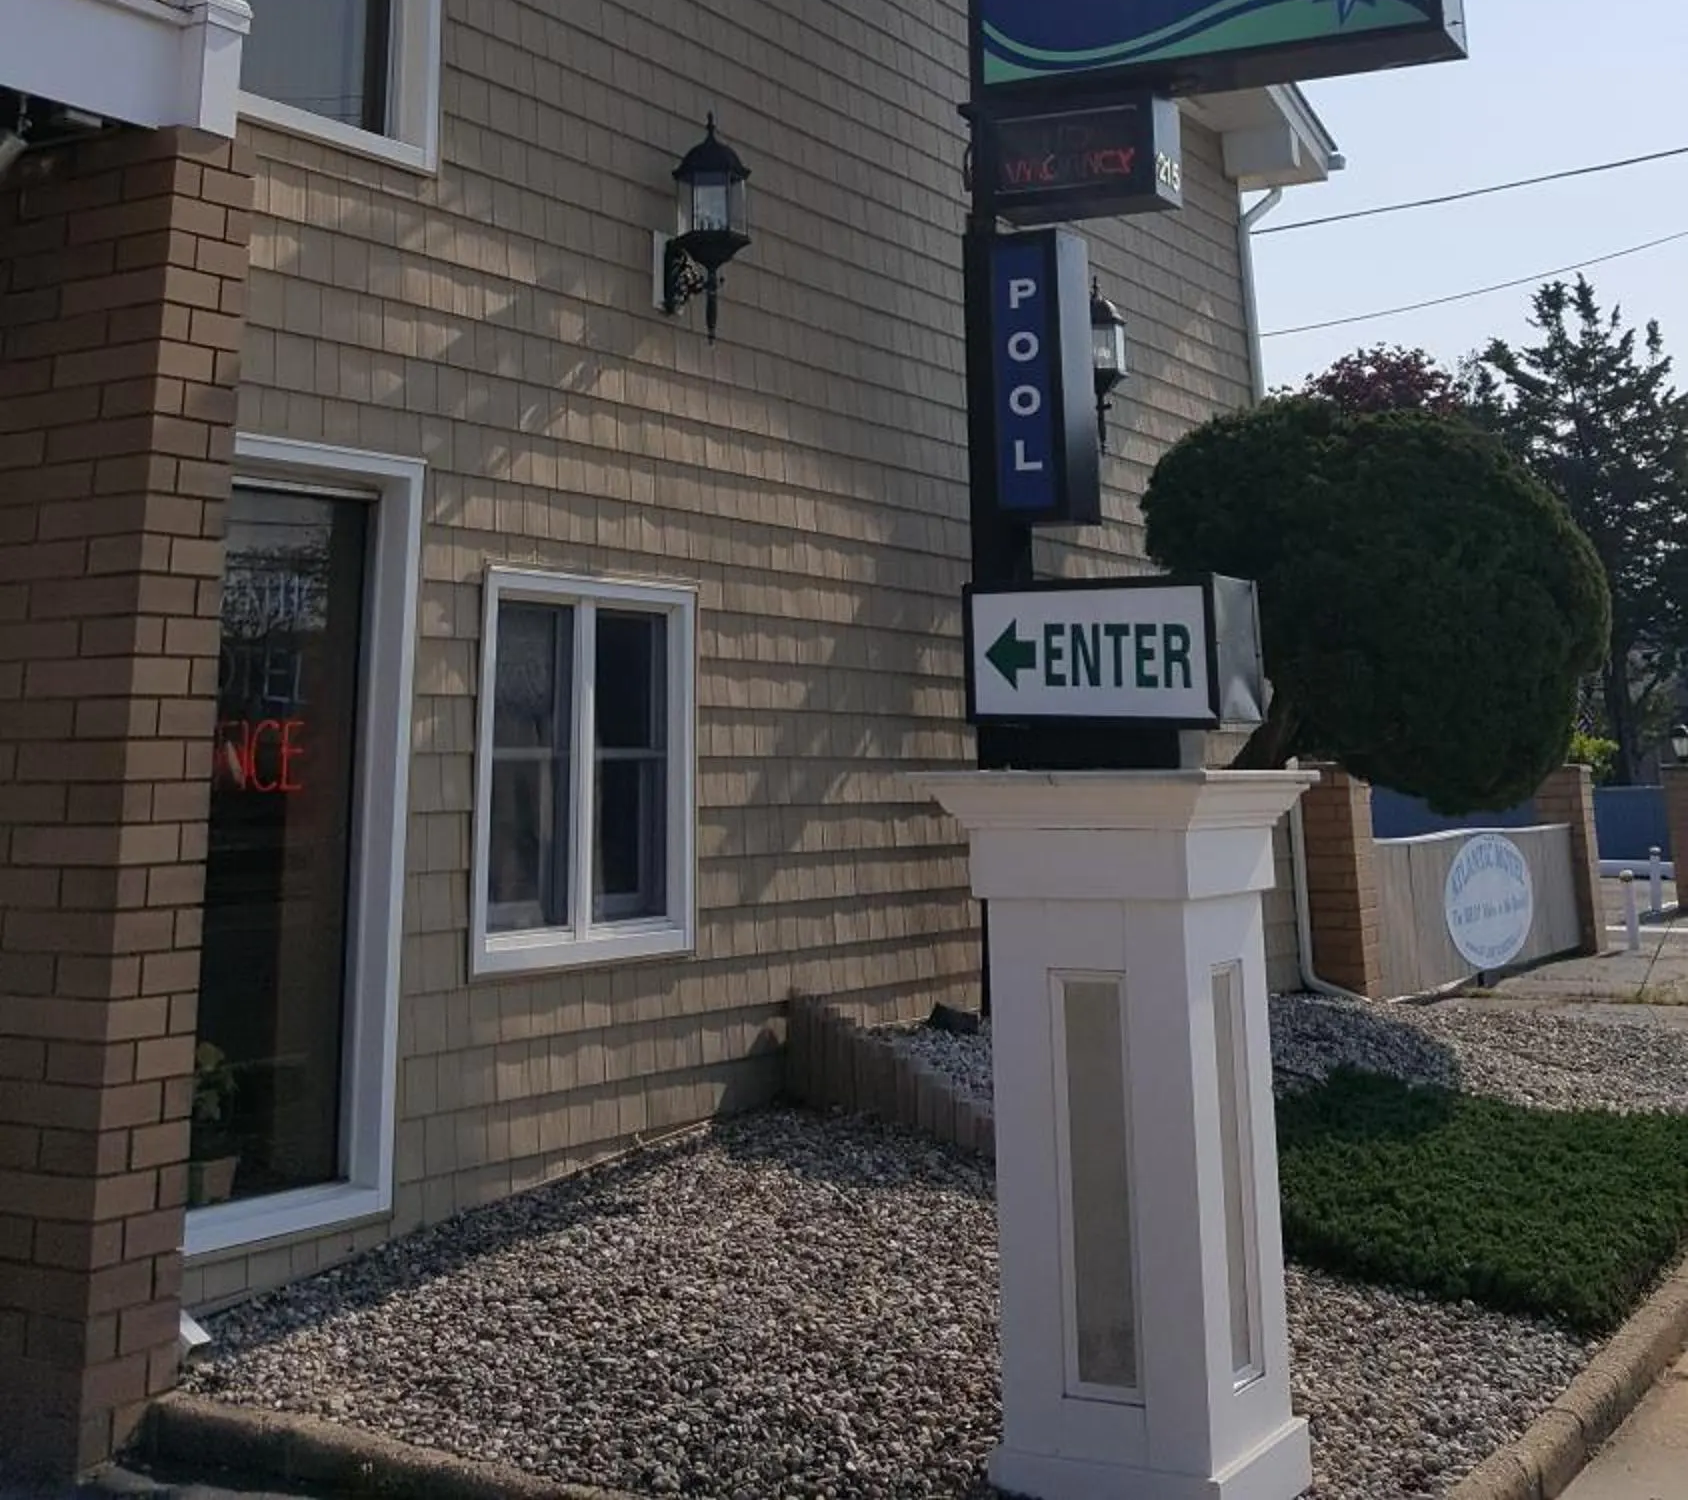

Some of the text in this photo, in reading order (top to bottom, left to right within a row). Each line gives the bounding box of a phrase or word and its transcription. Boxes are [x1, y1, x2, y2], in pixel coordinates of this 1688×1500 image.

[1156, 150, 1181, 194] 215
[1007, 278, 1044, 472] POOL
[1042, 622, 1193, 689] ENTER
